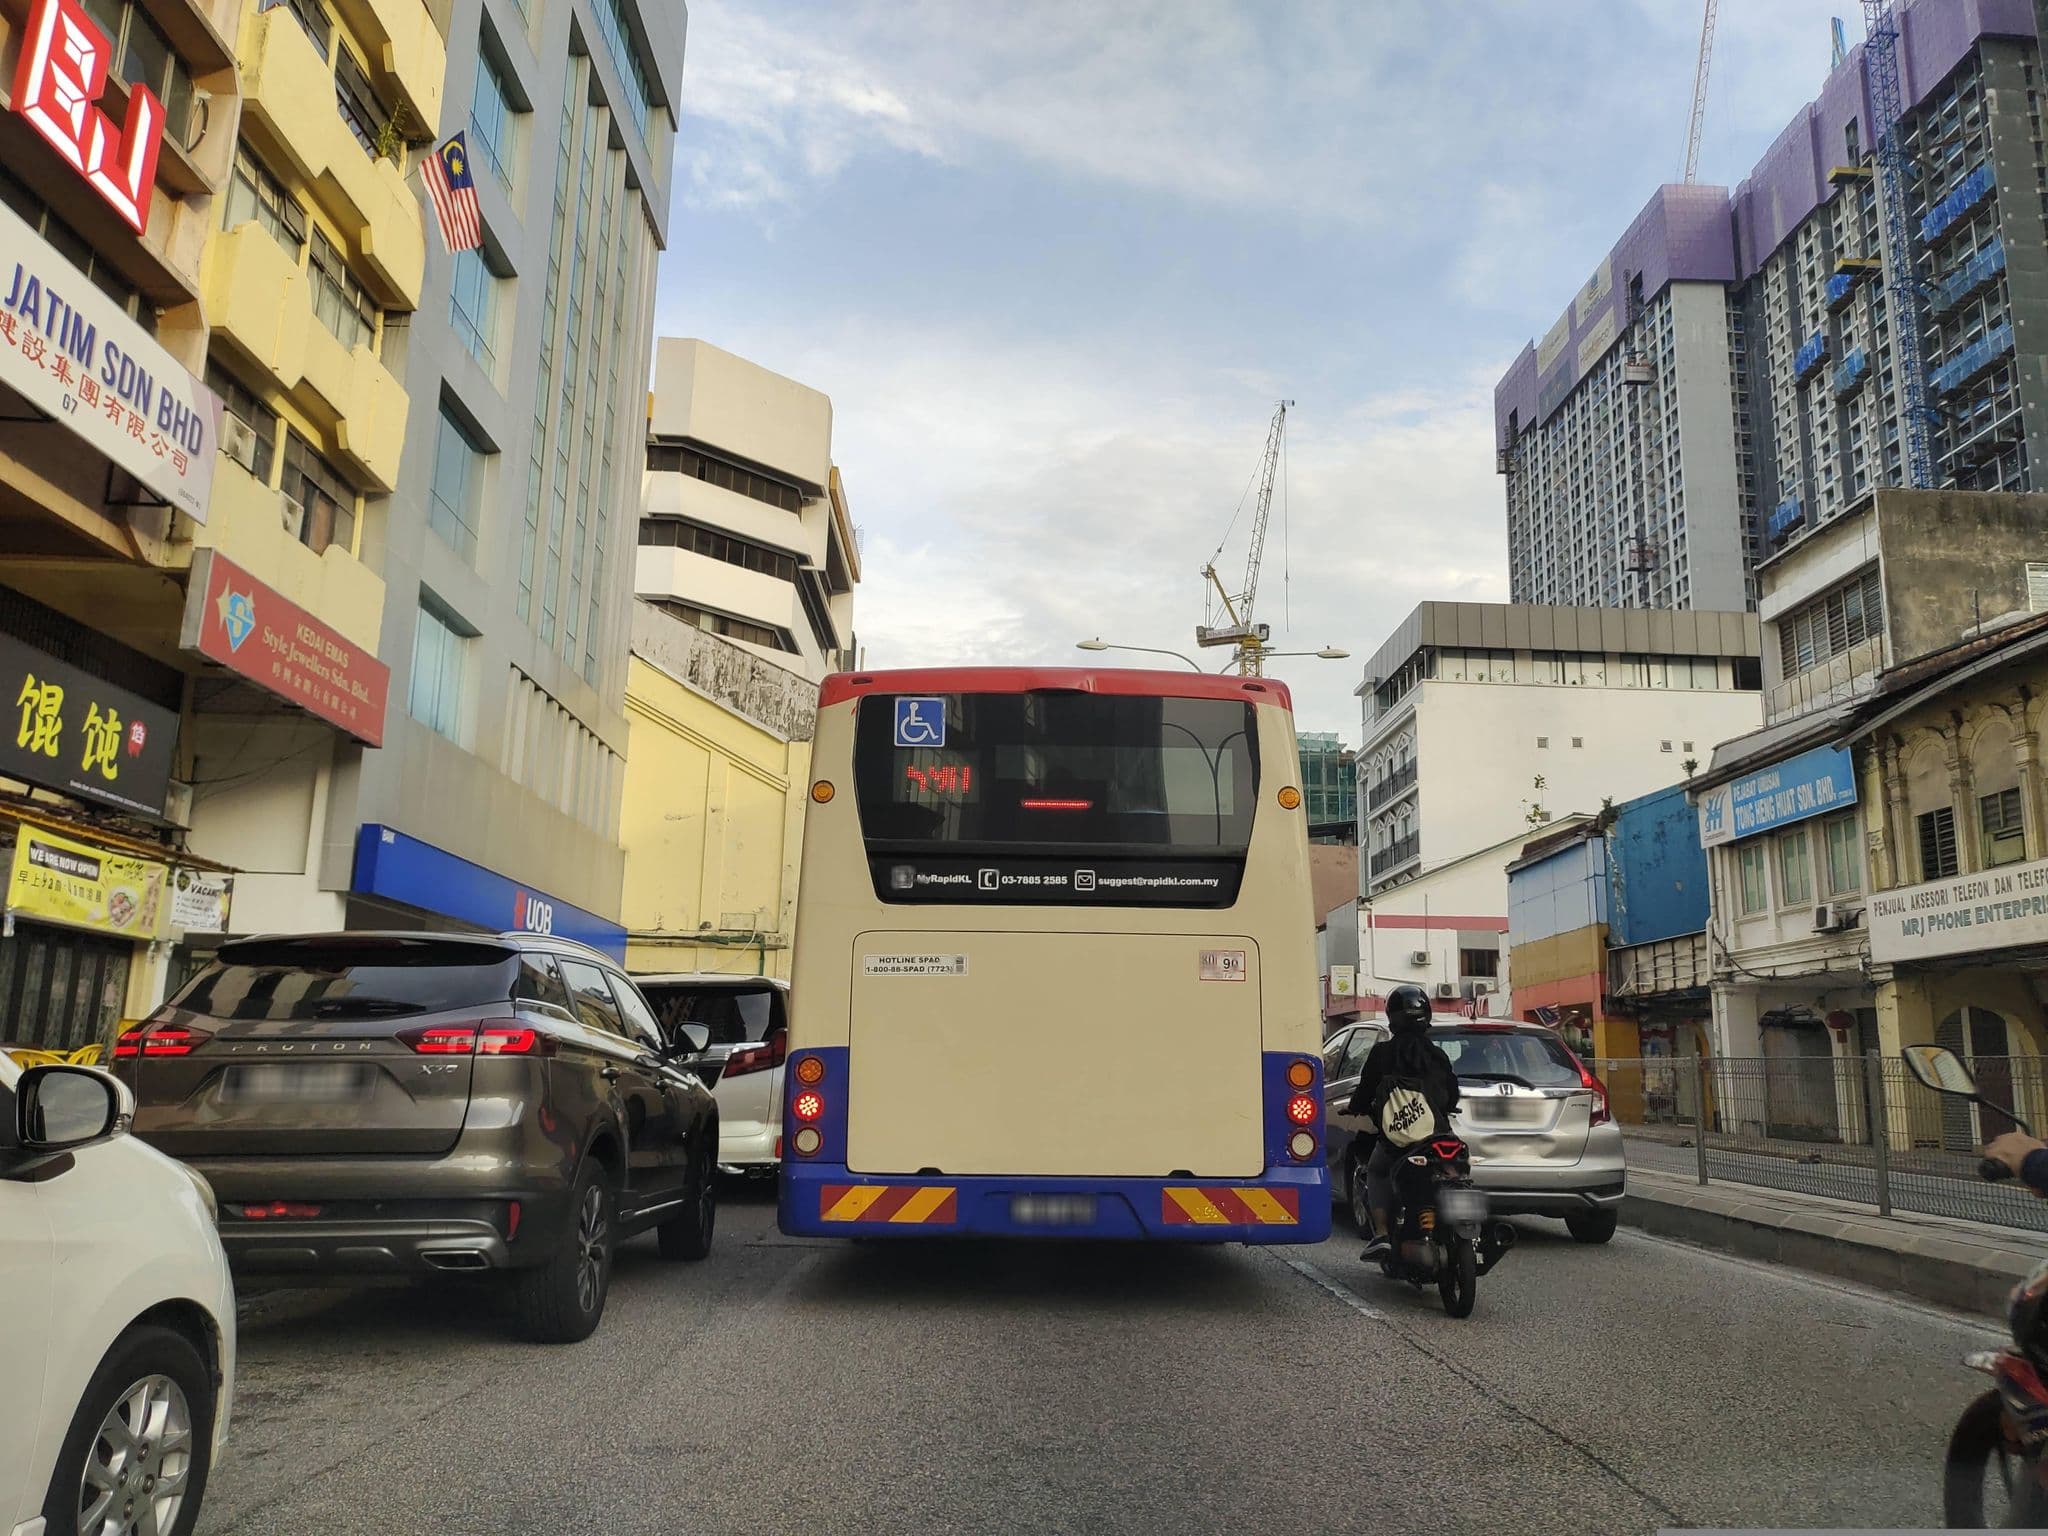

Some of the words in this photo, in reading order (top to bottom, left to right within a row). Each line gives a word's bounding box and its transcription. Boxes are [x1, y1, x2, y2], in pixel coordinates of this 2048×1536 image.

[5, 262, 97, 369] JATIM
[101, 340, 153, 417] SDN
[157, 387, 204, 456] BHD
[263, 625, 289, 655] Style
[286, 643, 330, 680] Jewellers
[332, 667, 350, 692] Sdn.
[296, 623, 324, 651] KEDAI
[325, 640, 349, 669] EMAS
[16, 672, 123, 781] 馄饨
[1735, 803, 1756, 832] TONG
[1756, 796, 1776, 825] HENG
[1776, 788, 1796, 818] HUAT
[1797, 782, 1816, 812] SDN.
[1815, 775, 1837, 807] BHD.
[30, 847, 44, 861] WE
[44, 852, 59, 866] ARE
[59, 857, 77, 871] NOW
[916, 874, 972, 885] MyRapidKL
[1001, 875, 1041, 885] 03-7885
[1043, 876, 1068, 885] 2585
[1098, 876, 1219, 888] suggest@rapidkl.com.my
[1873, 897, 1906, 918] PENJUAL
[1910, 888, 1949, 911] AKSESORI
[1953, 880, 1989, 903] TELEFON
[1995, 874, 2012, 895] DAN
[525, 898, 552, 934] UOB
[1901, 915, 1925, 938] MRJ
[1928, 908, 1972, 933] PHONE
[231, 1041, 373, 1052] PROTON
[1388, 1103, 1425, 1133] MONKEYS
